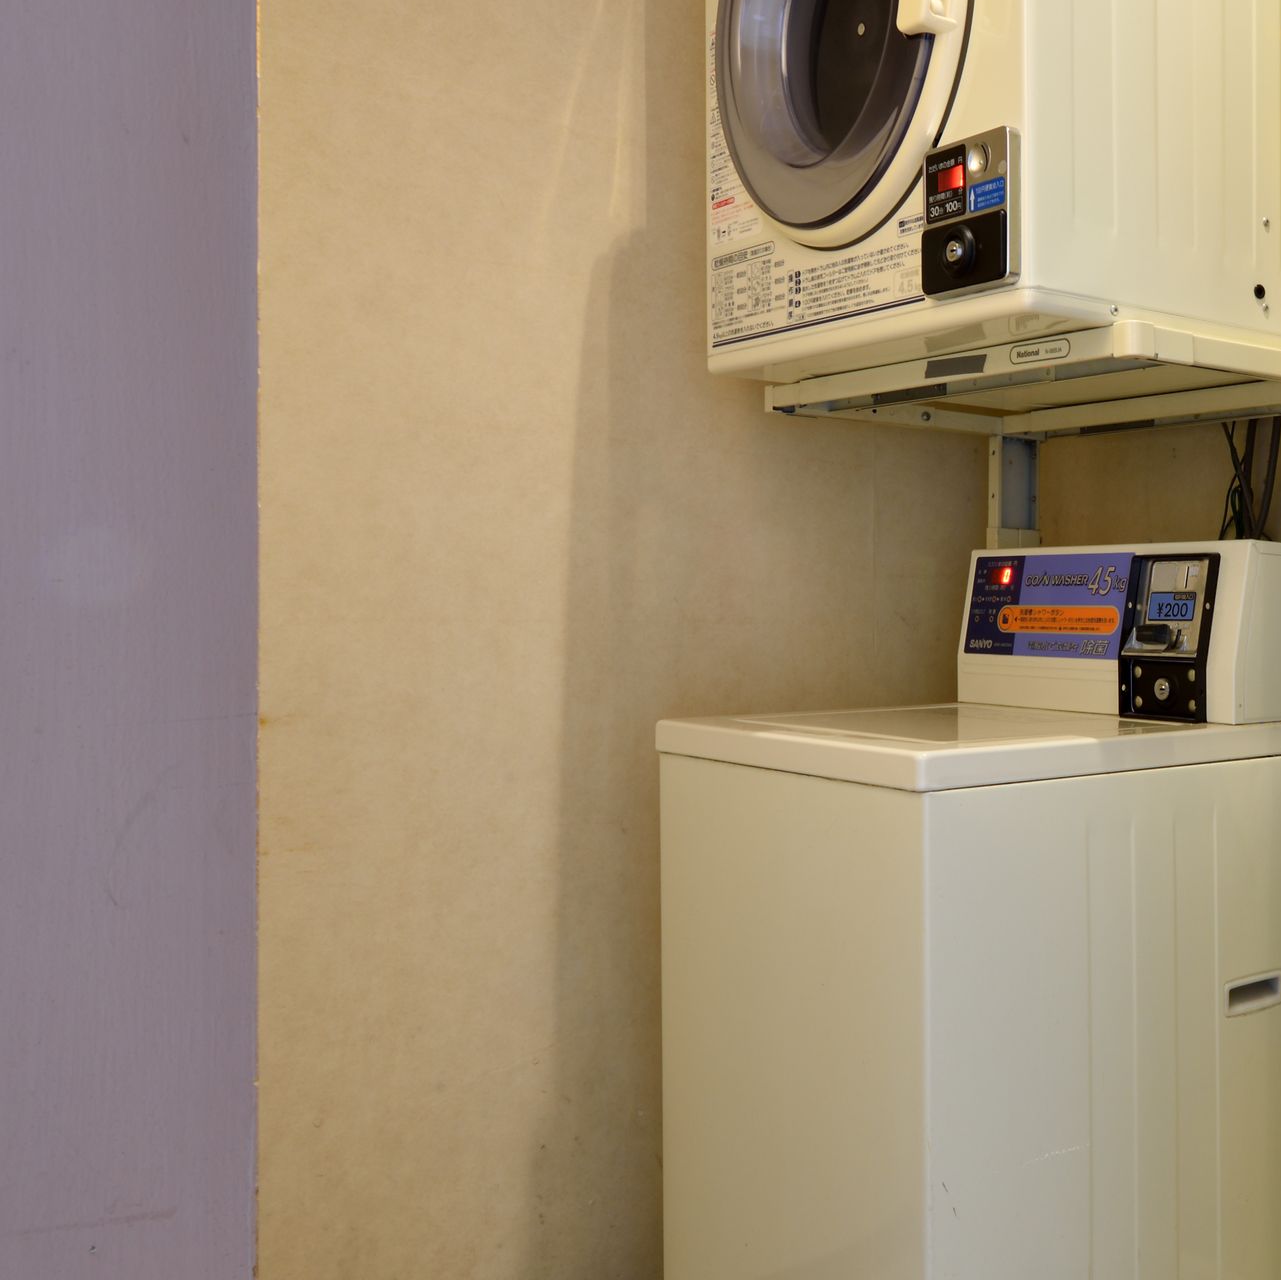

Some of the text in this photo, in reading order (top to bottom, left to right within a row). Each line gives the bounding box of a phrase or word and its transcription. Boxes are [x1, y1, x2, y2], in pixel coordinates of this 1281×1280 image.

[1051, 574, 1089, 587] WASHER
[1157, 602, 1188, 618] ¥200
[969, 638, 993, 650] SANYO
